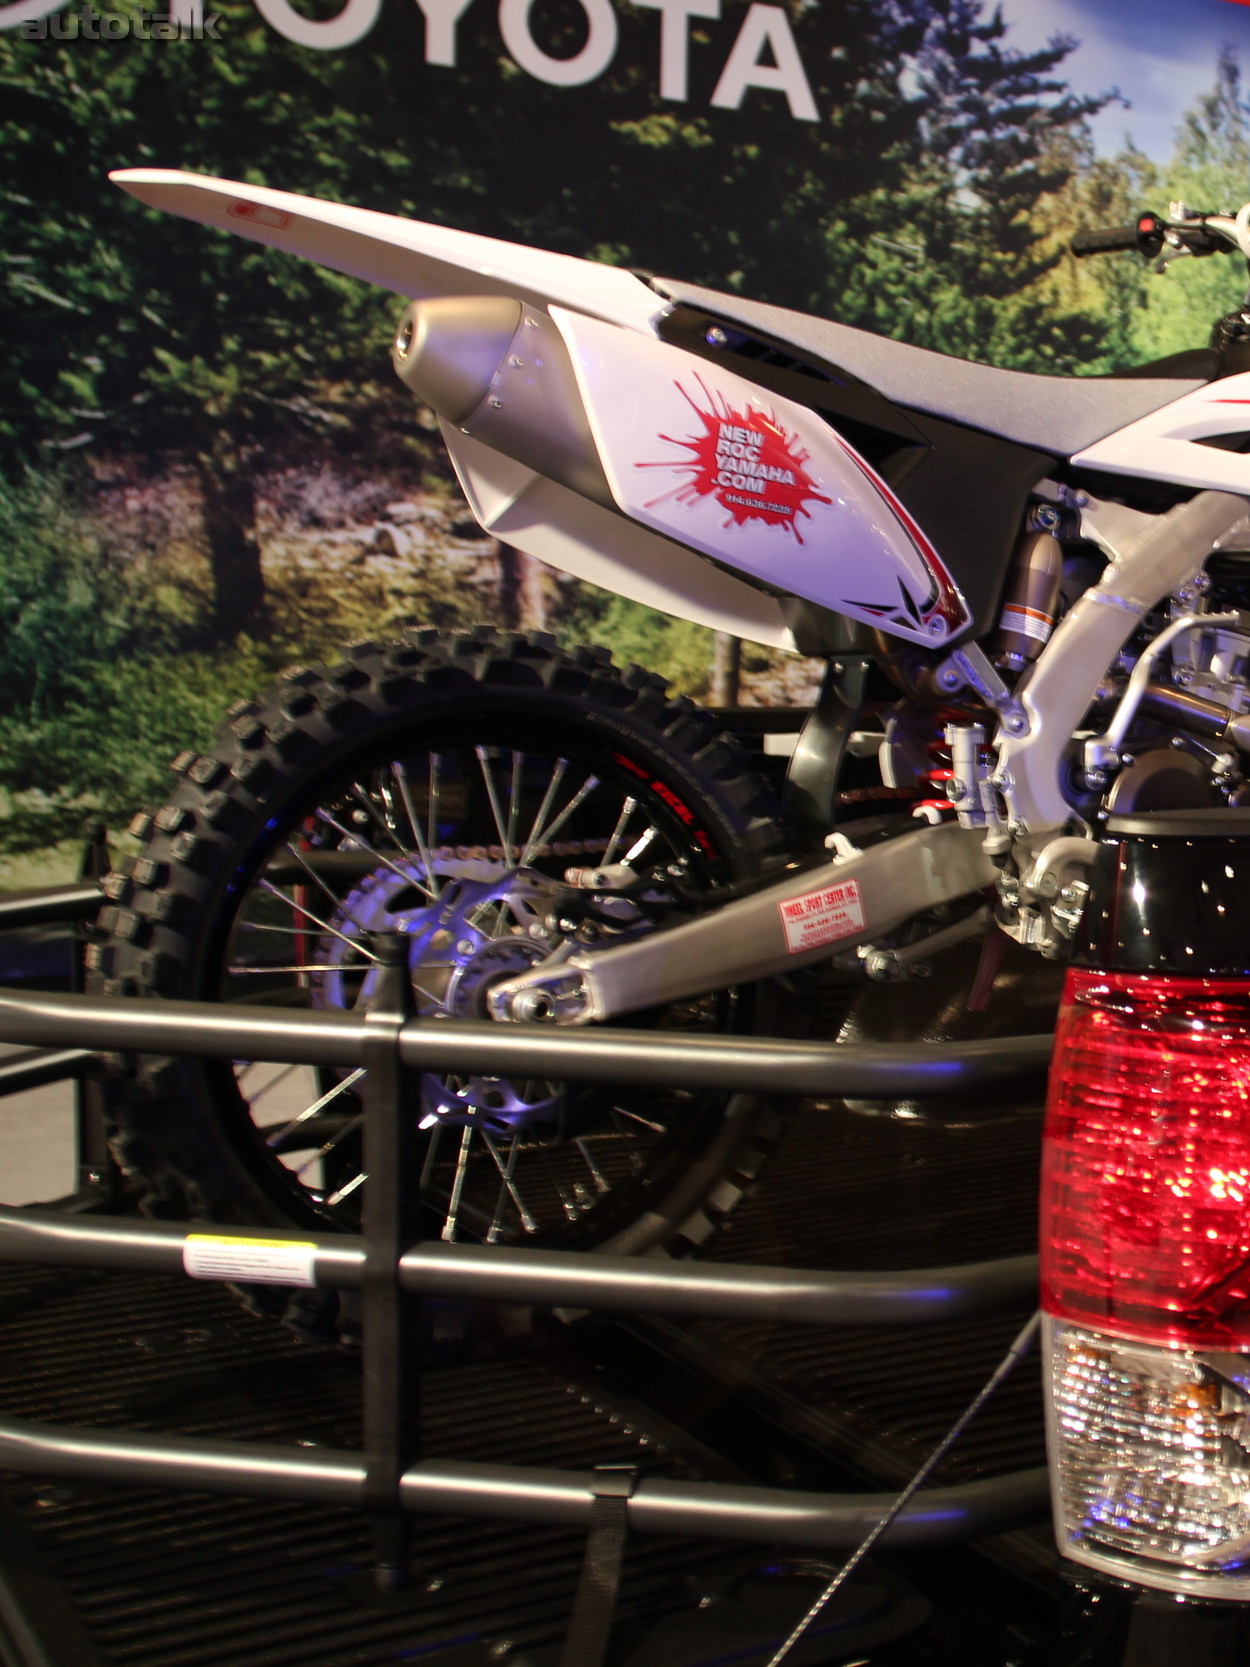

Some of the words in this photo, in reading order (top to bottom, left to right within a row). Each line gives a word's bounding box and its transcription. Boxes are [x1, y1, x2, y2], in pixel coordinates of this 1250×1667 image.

[170, 0, 822, 123] YOTA
[719, 422, 765, 448] NEW
[717, 438, 761, 462] ROC
[715, 452, 796, 486] YAMAHA
[711, 471, 766, 494] .COM
